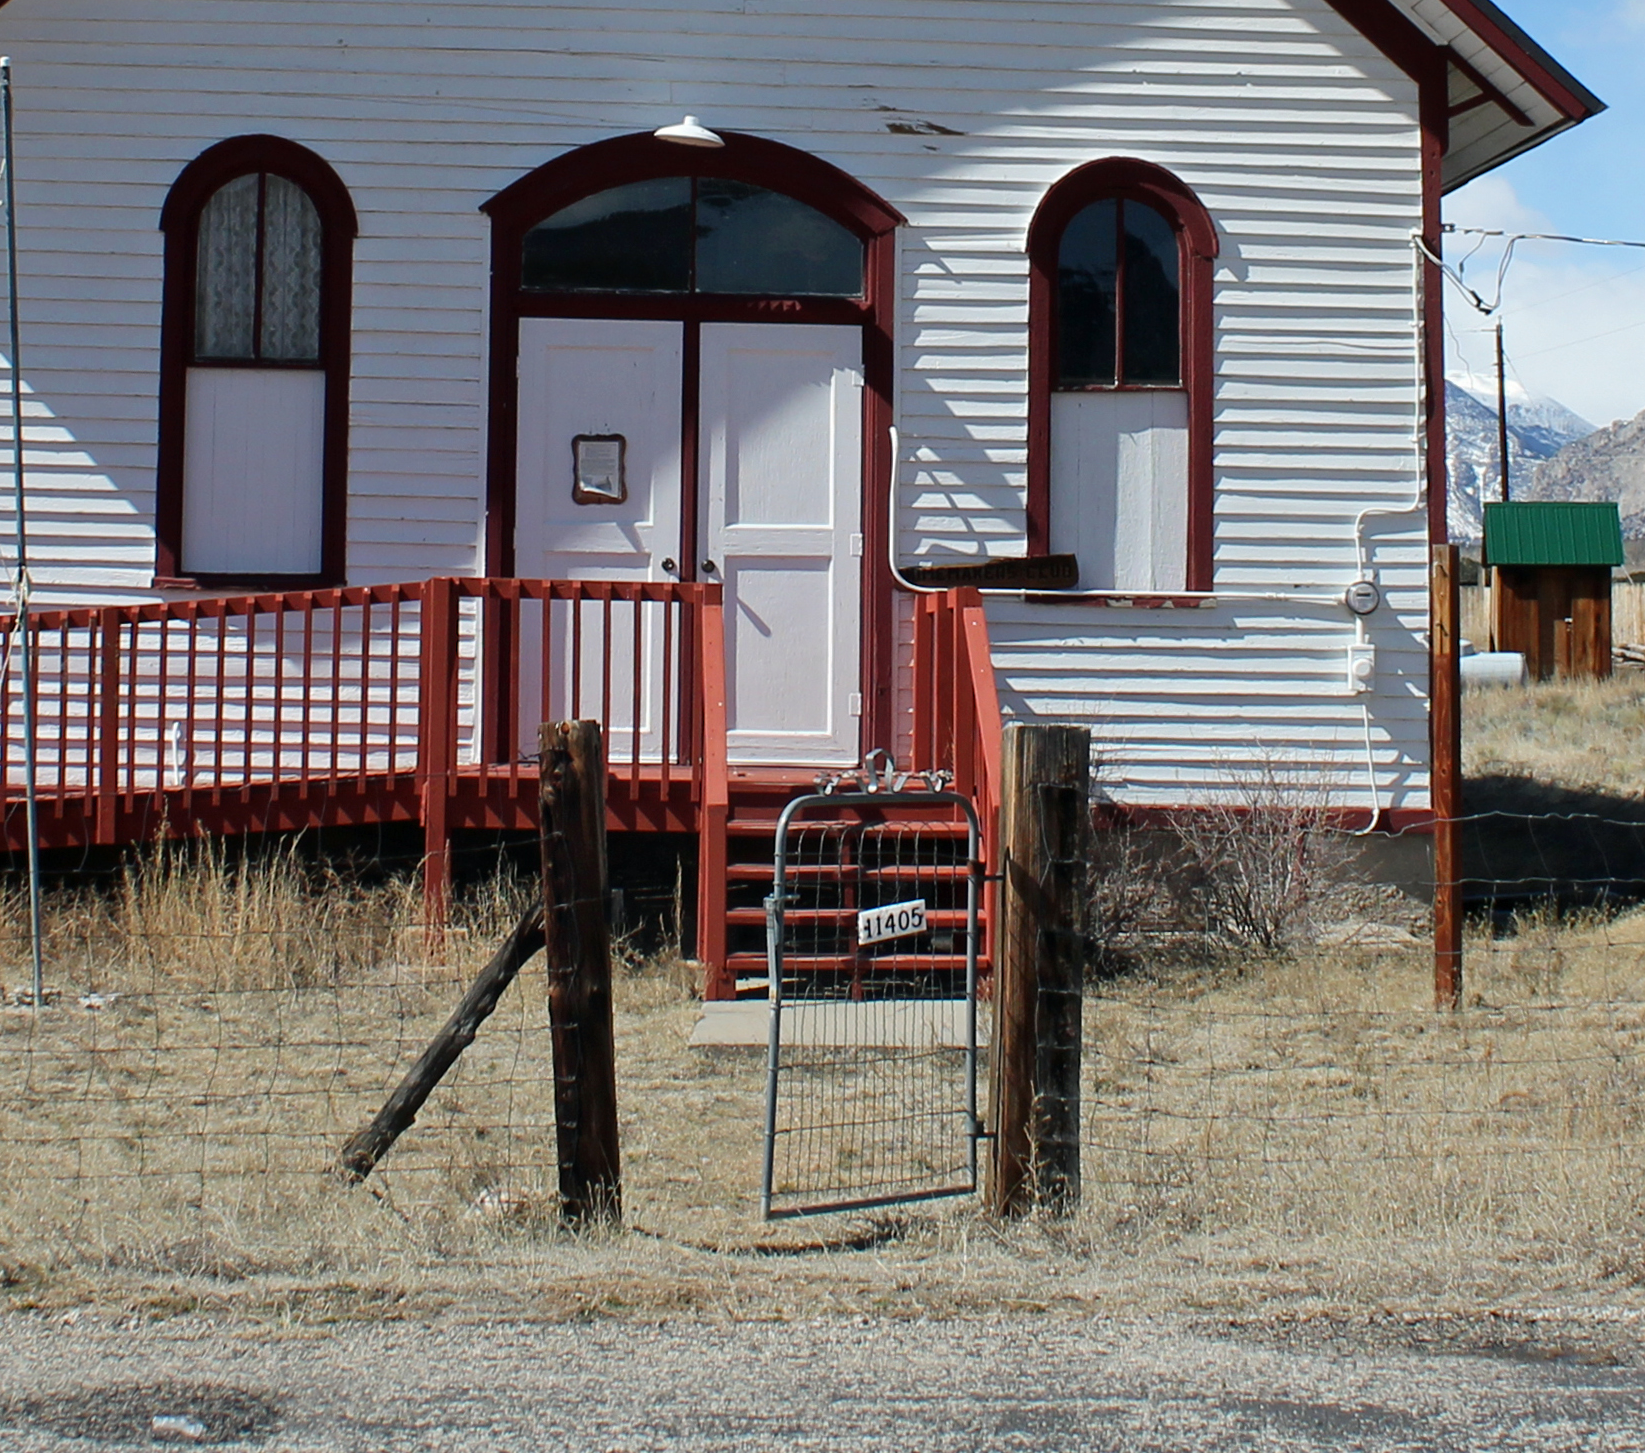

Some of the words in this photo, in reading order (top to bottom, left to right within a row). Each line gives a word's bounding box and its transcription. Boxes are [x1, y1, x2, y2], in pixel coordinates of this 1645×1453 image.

[909, 563, 1015, 581] OMEMAKERS
[1025, 563, 1072, 580] CLUB
[865, 907, 924, 938] 11405
